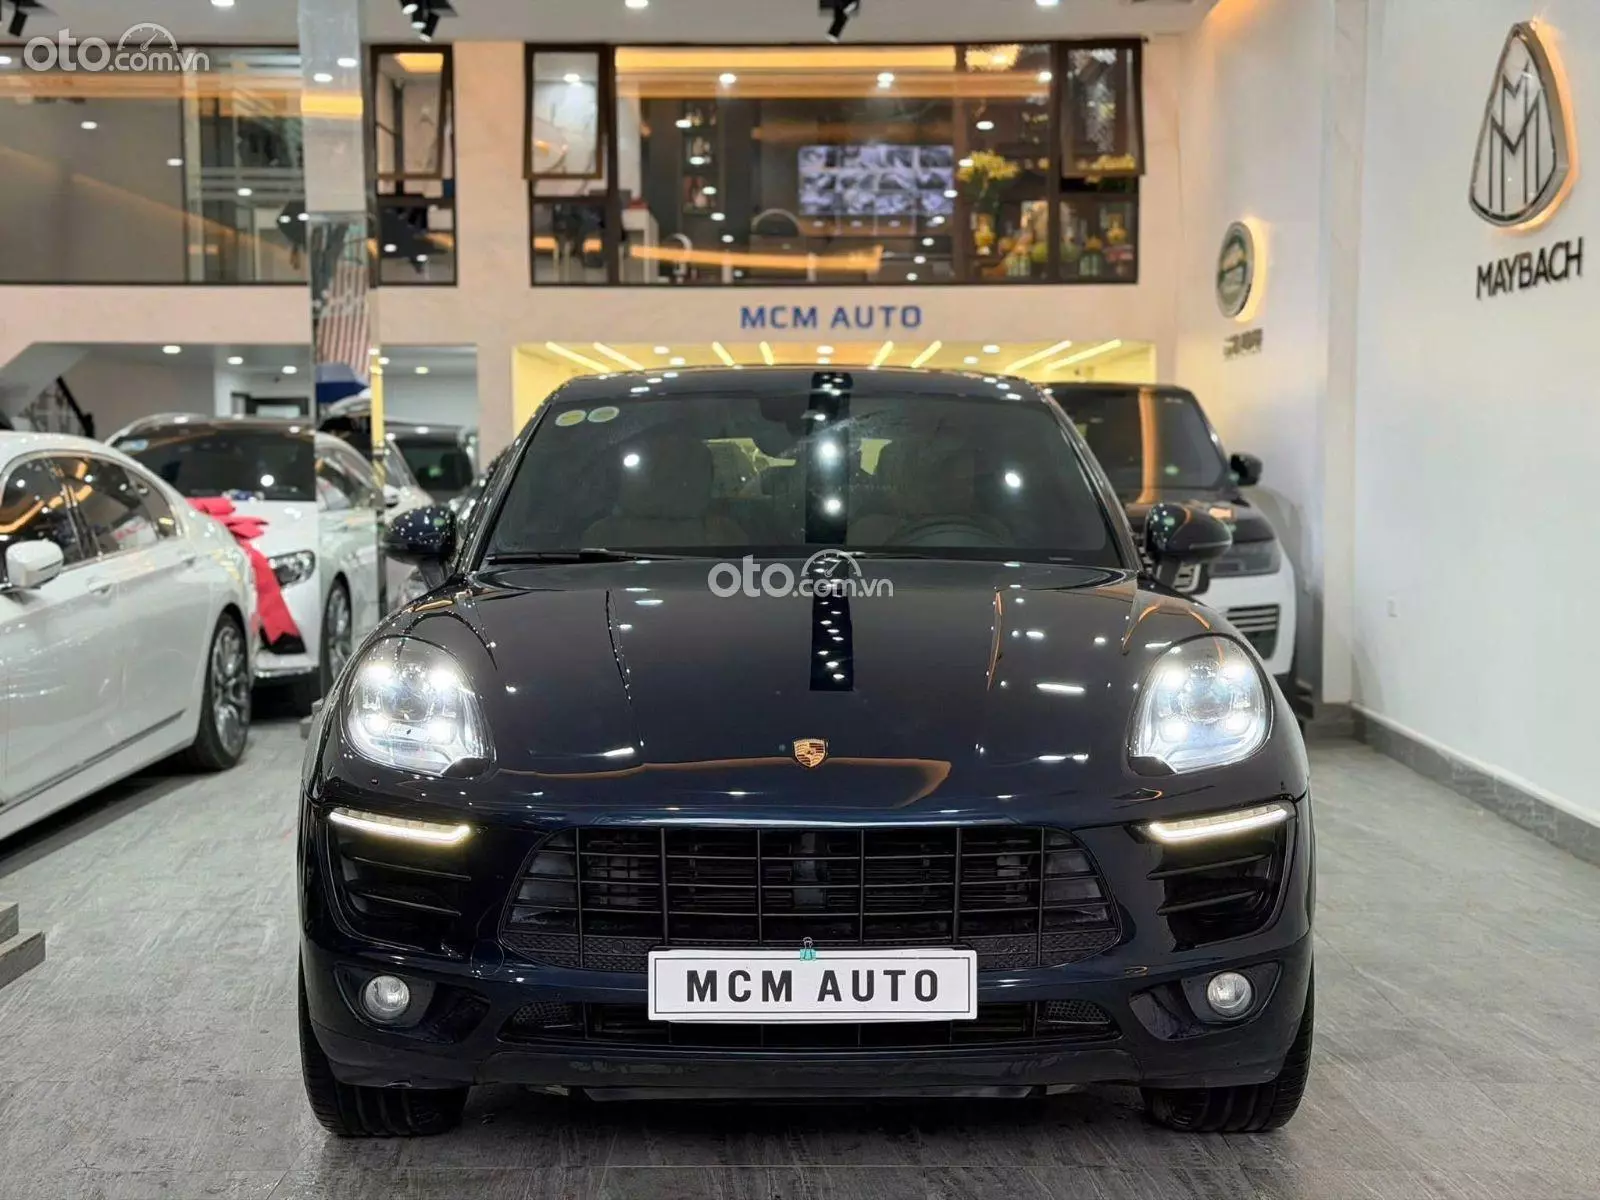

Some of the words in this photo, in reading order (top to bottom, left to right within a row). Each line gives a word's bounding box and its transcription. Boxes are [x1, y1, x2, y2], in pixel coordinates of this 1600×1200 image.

[1476, 236, 1584, 300] MAYBACH
[740, 305, 818, 329] MCM
[830, 305, 922, 329] AUTO
[686, 969, 792, 1002] MCM
[817, 969, 938, 1002] AUTO
